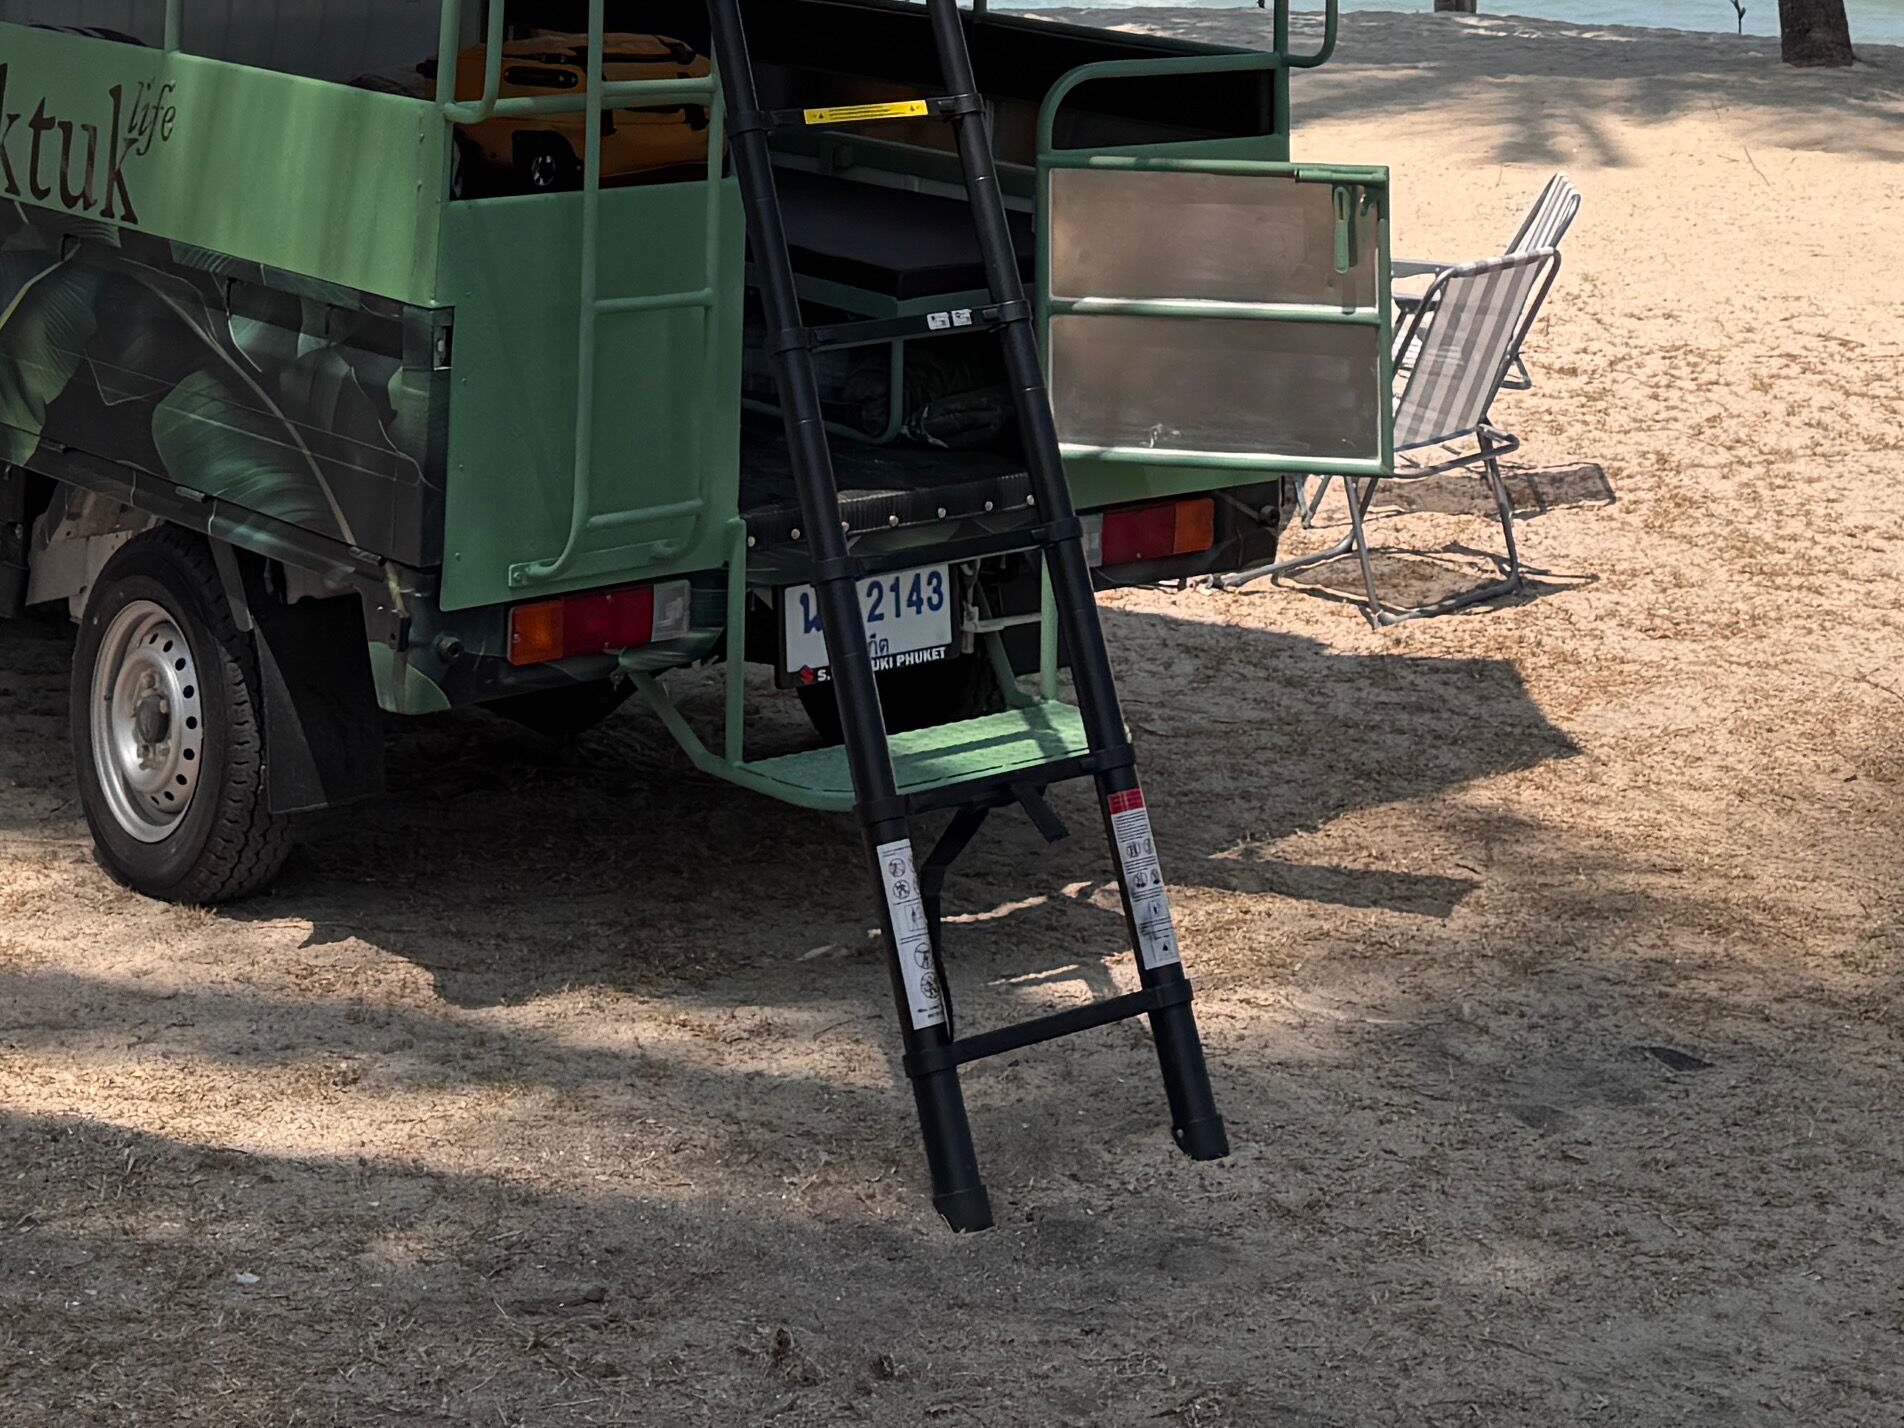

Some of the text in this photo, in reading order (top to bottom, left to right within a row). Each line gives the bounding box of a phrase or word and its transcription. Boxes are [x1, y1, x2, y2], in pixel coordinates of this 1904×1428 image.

[128, 76, 176, 156] life
[866, 570, 944, 623] 2143
[871, 656, 893, 672] UKI
[896, 646, 947, 667] PHUKET
